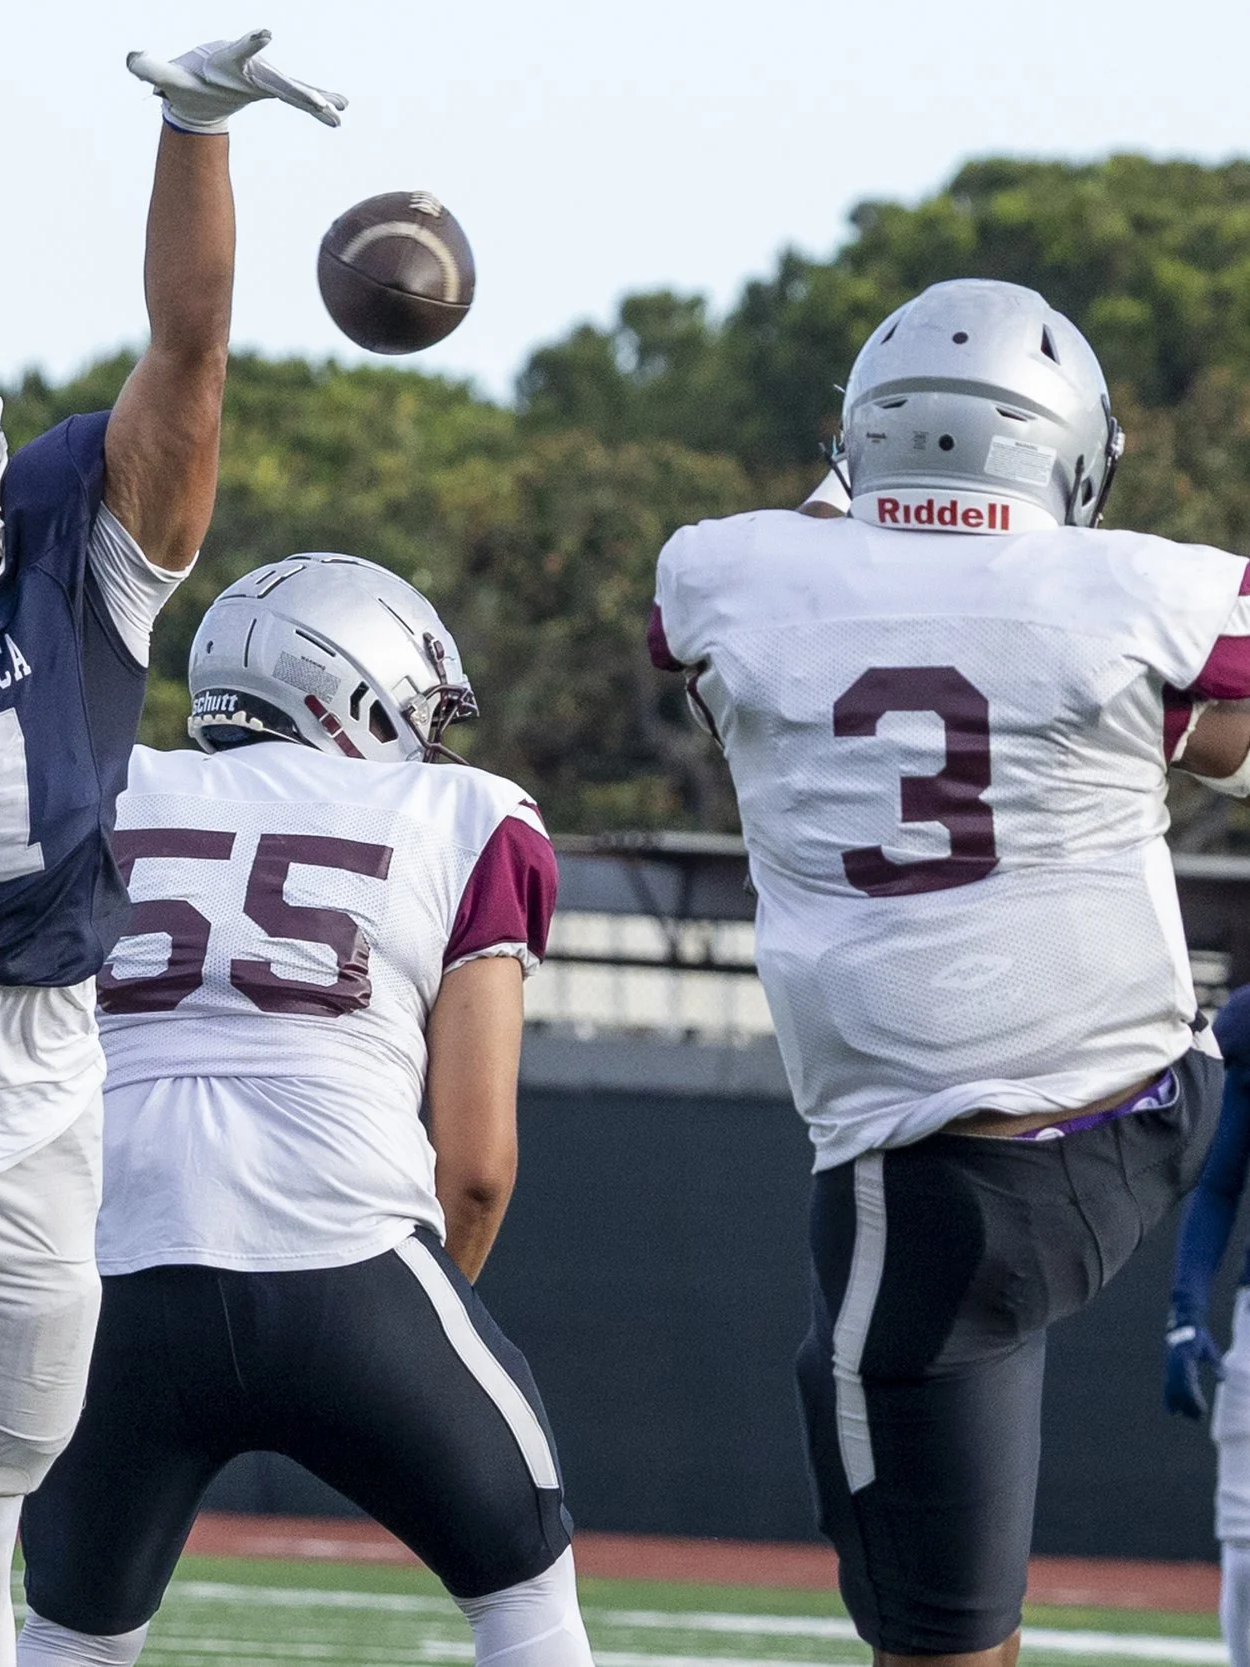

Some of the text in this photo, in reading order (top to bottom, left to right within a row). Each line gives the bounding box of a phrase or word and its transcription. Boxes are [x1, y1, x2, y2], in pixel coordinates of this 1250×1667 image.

[877, 497, 1010, 531] Riddell
[833, 666, 1000, 898] 3
[96, 828, 394, 1018] 55
